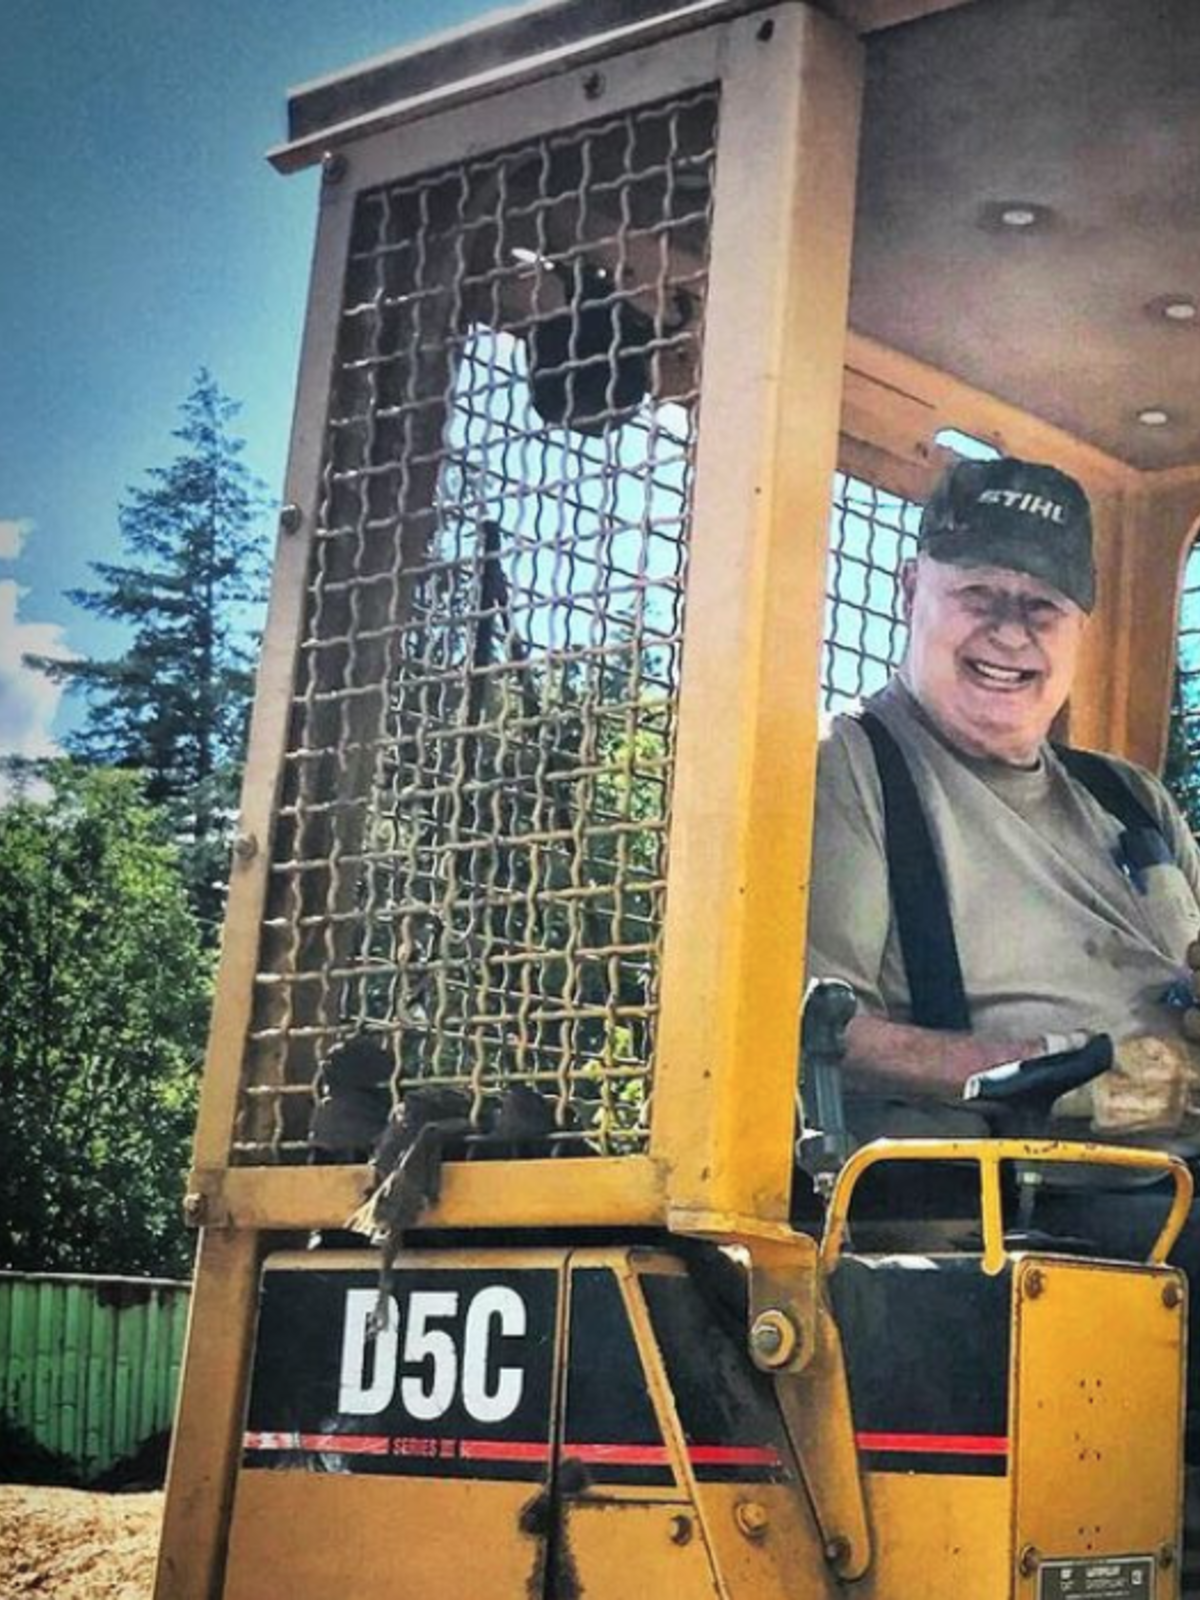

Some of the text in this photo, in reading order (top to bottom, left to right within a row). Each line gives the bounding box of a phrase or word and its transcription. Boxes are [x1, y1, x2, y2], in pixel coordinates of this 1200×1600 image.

[978, 488, 1067, 525] STIHL
[337, 1285, 527, 1423] D5C
[393, 1437, 437, 1457] SERIES
